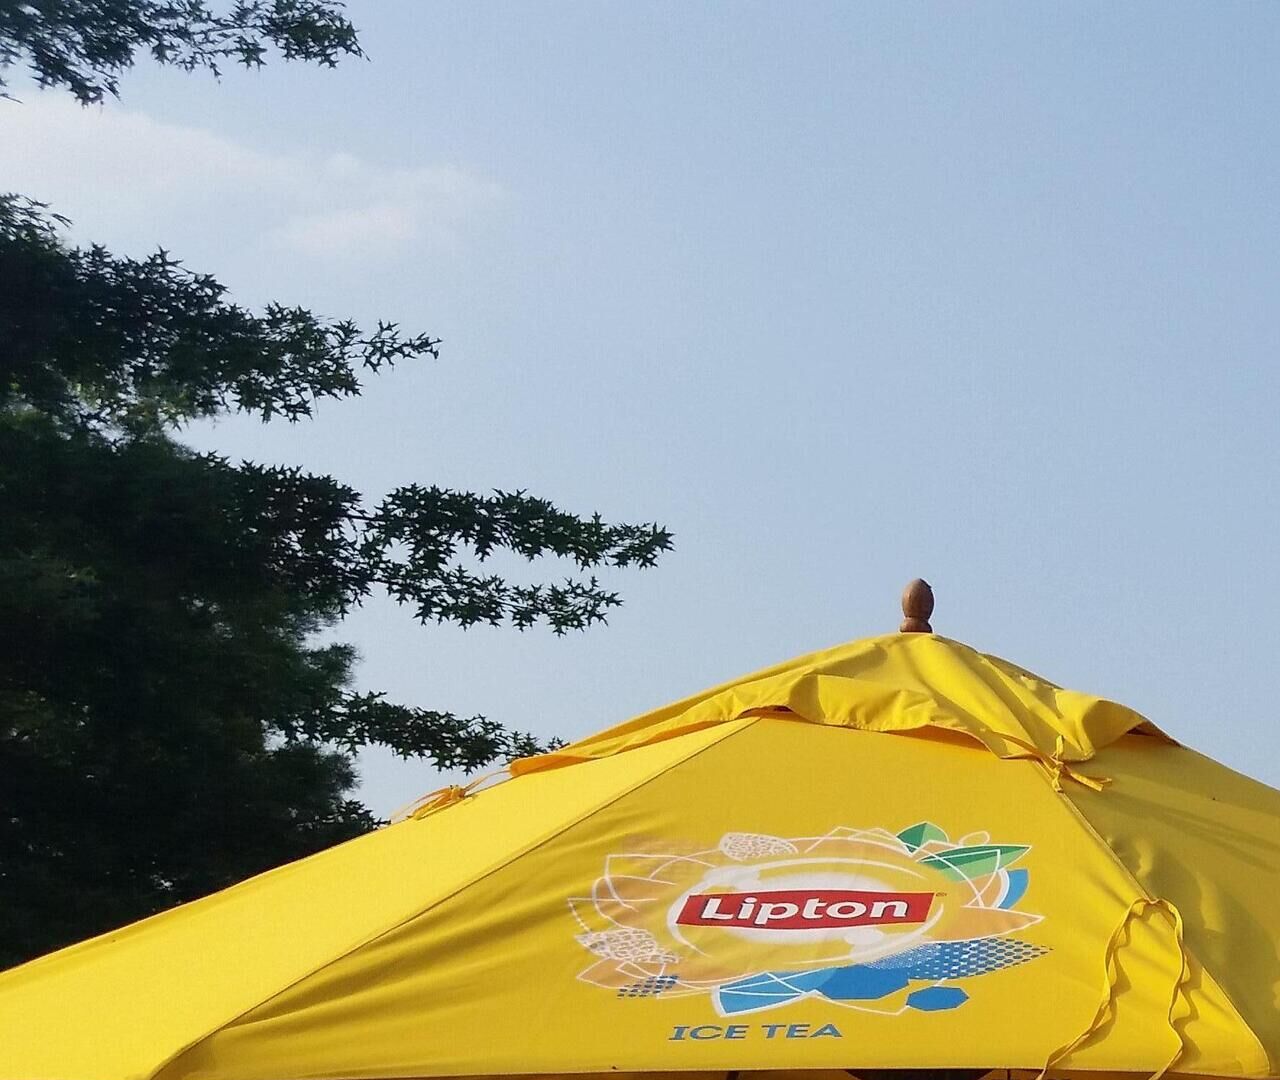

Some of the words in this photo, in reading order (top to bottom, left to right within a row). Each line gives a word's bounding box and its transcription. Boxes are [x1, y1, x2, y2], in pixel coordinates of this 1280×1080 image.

[701, 897, 909, 925] Lipton
[668, 1024, 750, 1041] ICE
[761, 1023, 843, 1039] TEA
